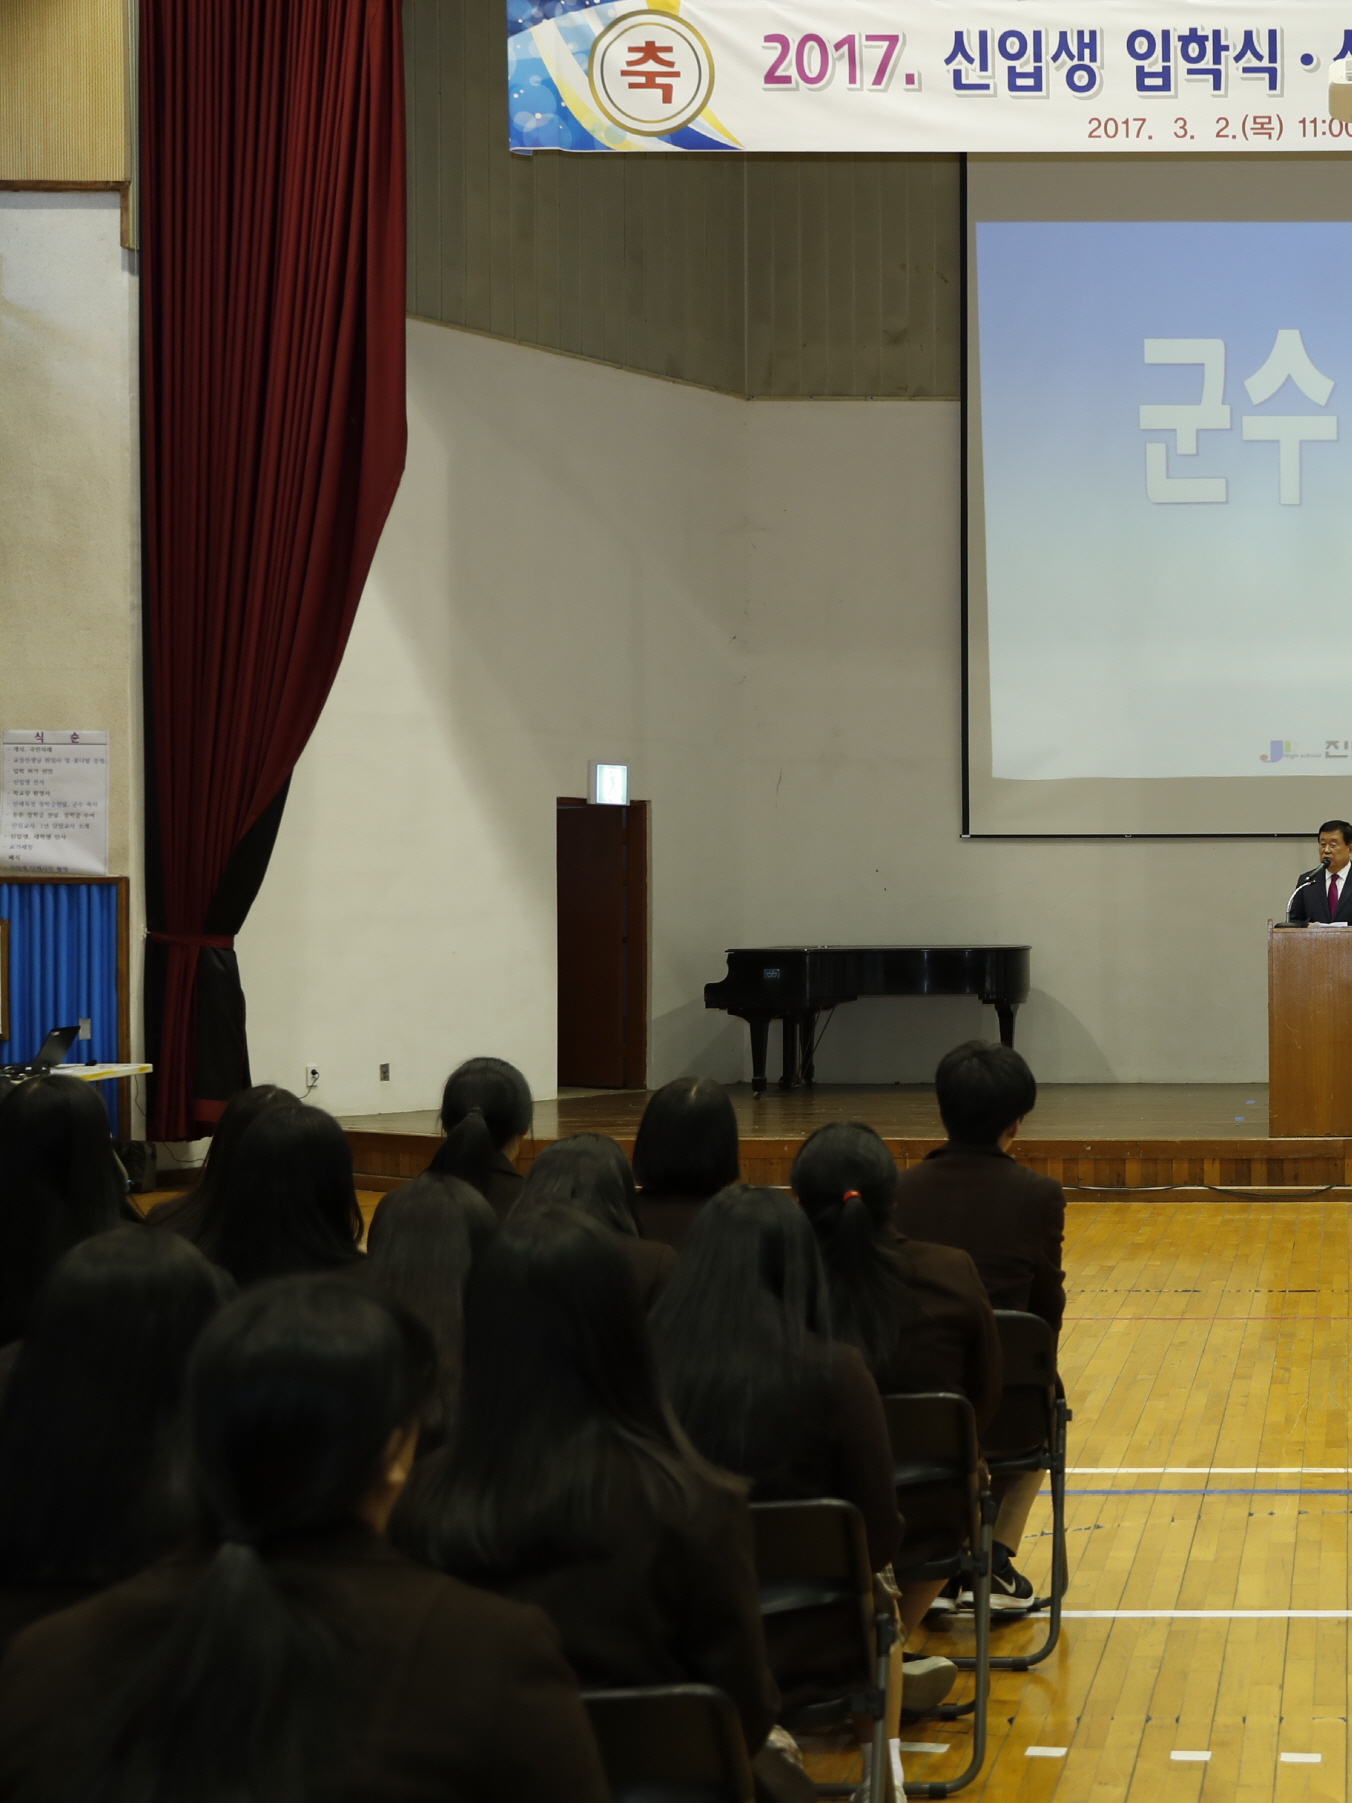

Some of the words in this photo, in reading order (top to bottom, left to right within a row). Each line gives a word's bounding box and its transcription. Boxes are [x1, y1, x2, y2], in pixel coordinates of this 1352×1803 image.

[620, 40, 681, 104] 축
[764, 33, 914, 85] 2017.
[945, 30, 1097, 93] 신입생
[1127, 28, 1277, 92] 입학식
[1088, 117, 1153, 140] 2017.
[1174, 117, 1195, 139] 3.
[1138, 328, 1340, 506] 군수
[34, 731, 44, 744] 식
[70, 731, 80, 744] 순
